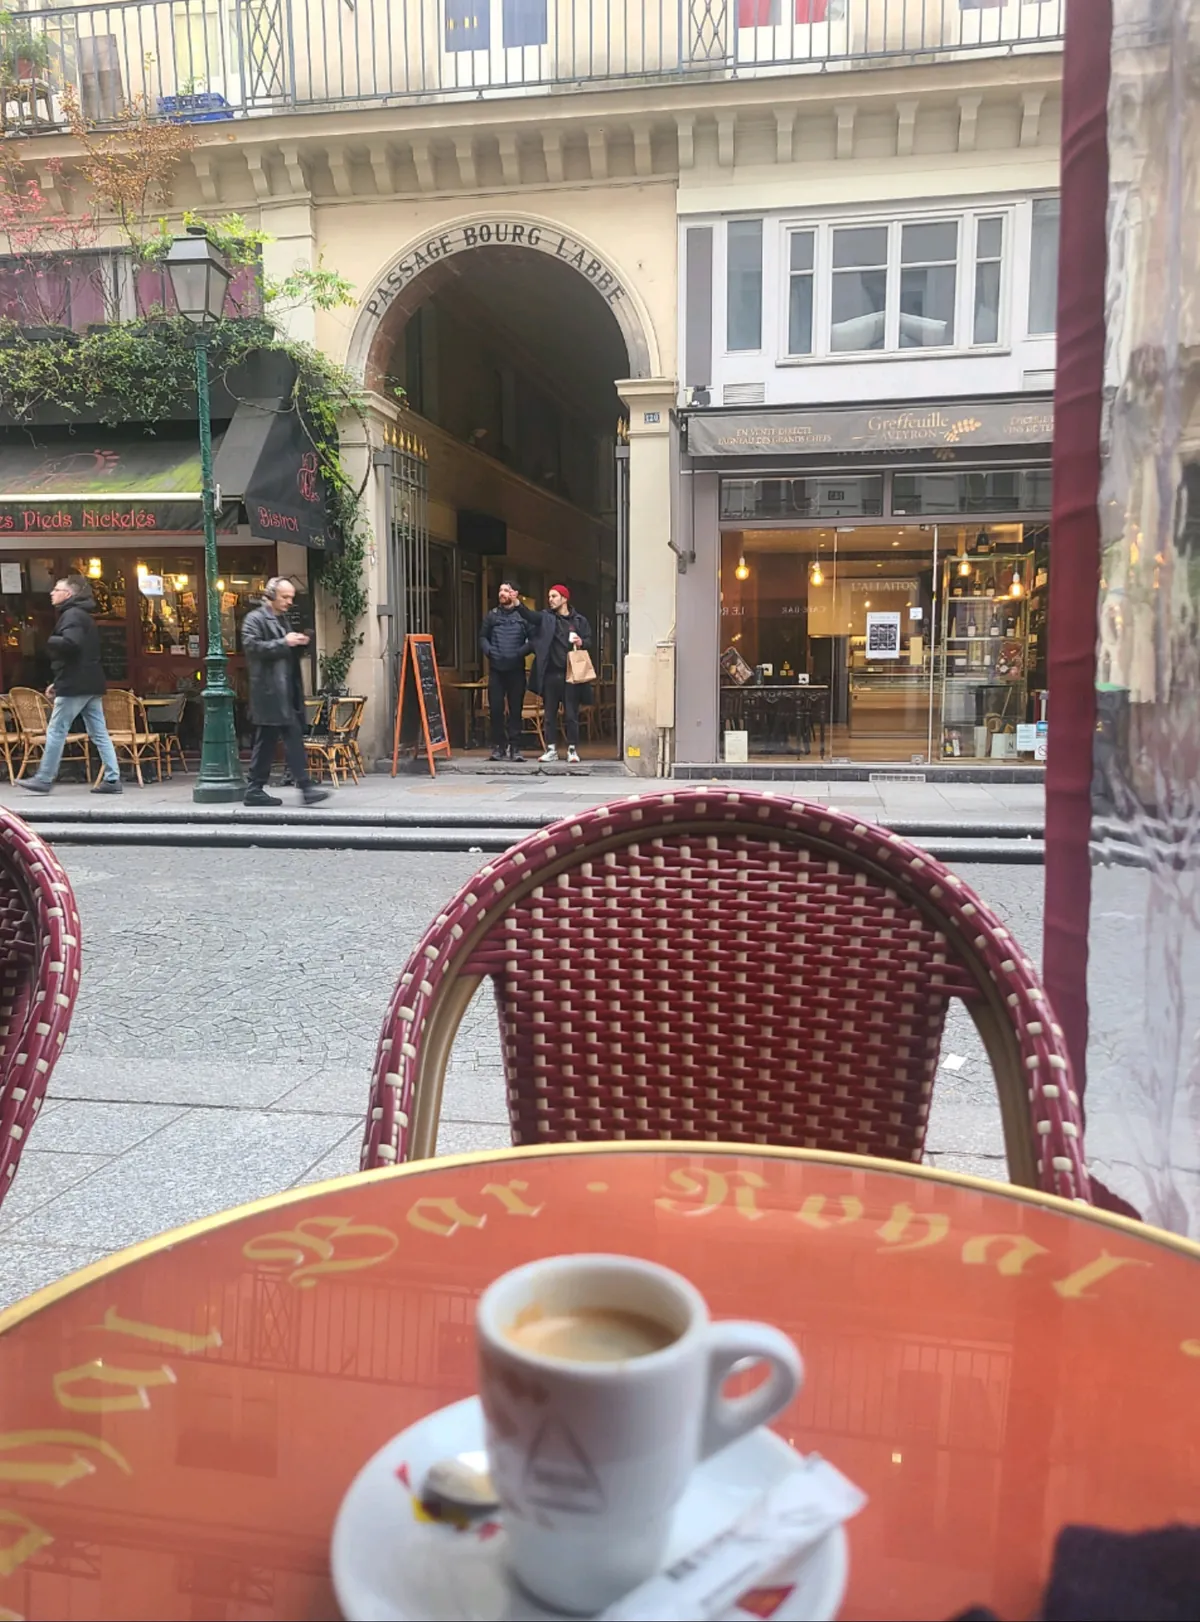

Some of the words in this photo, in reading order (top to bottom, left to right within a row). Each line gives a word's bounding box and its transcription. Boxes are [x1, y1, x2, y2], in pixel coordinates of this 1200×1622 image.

[366, 235, 453, 318] PASSAGE
[462, 223, 542, 247] BOURG
[868, 411, 949, 431] Greffeuille
[882, 429, 937, 441] AVEYRON
[22, 510, 73, 530] Pieds
[82, 508, 156, 529] Nickelés
[257, 506, 300, 532] Bistrot
[242, 1178, 547, 1289] Bar
[654, 1166, 1154, 1298] Royal
